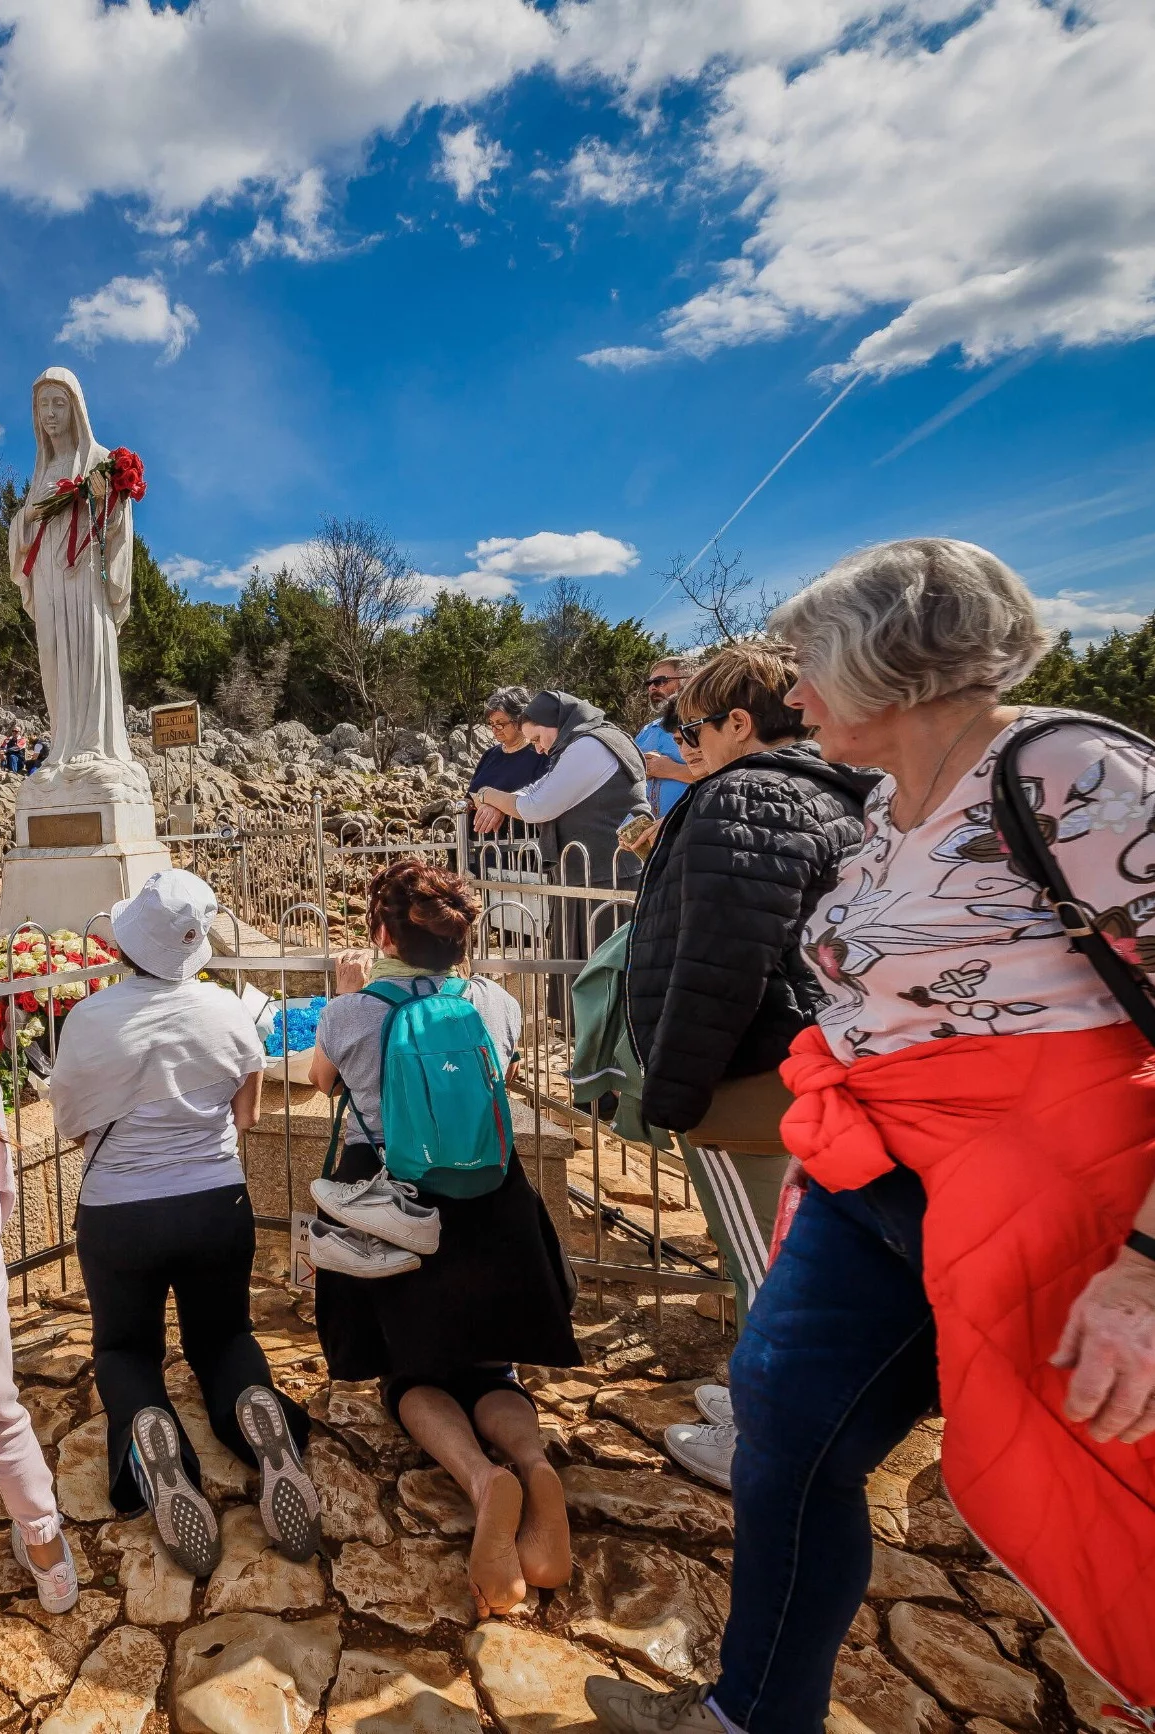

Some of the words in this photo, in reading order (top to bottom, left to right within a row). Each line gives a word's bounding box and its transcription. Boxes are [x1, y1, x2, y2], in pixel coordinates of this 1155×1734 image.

[155, 714, 194, 727] SILENTIUM
[160, 729, 191, 741] TIŠINA
[300, 1220, 311, 1229] PA
[300, 1233, 309, 1242] AT
